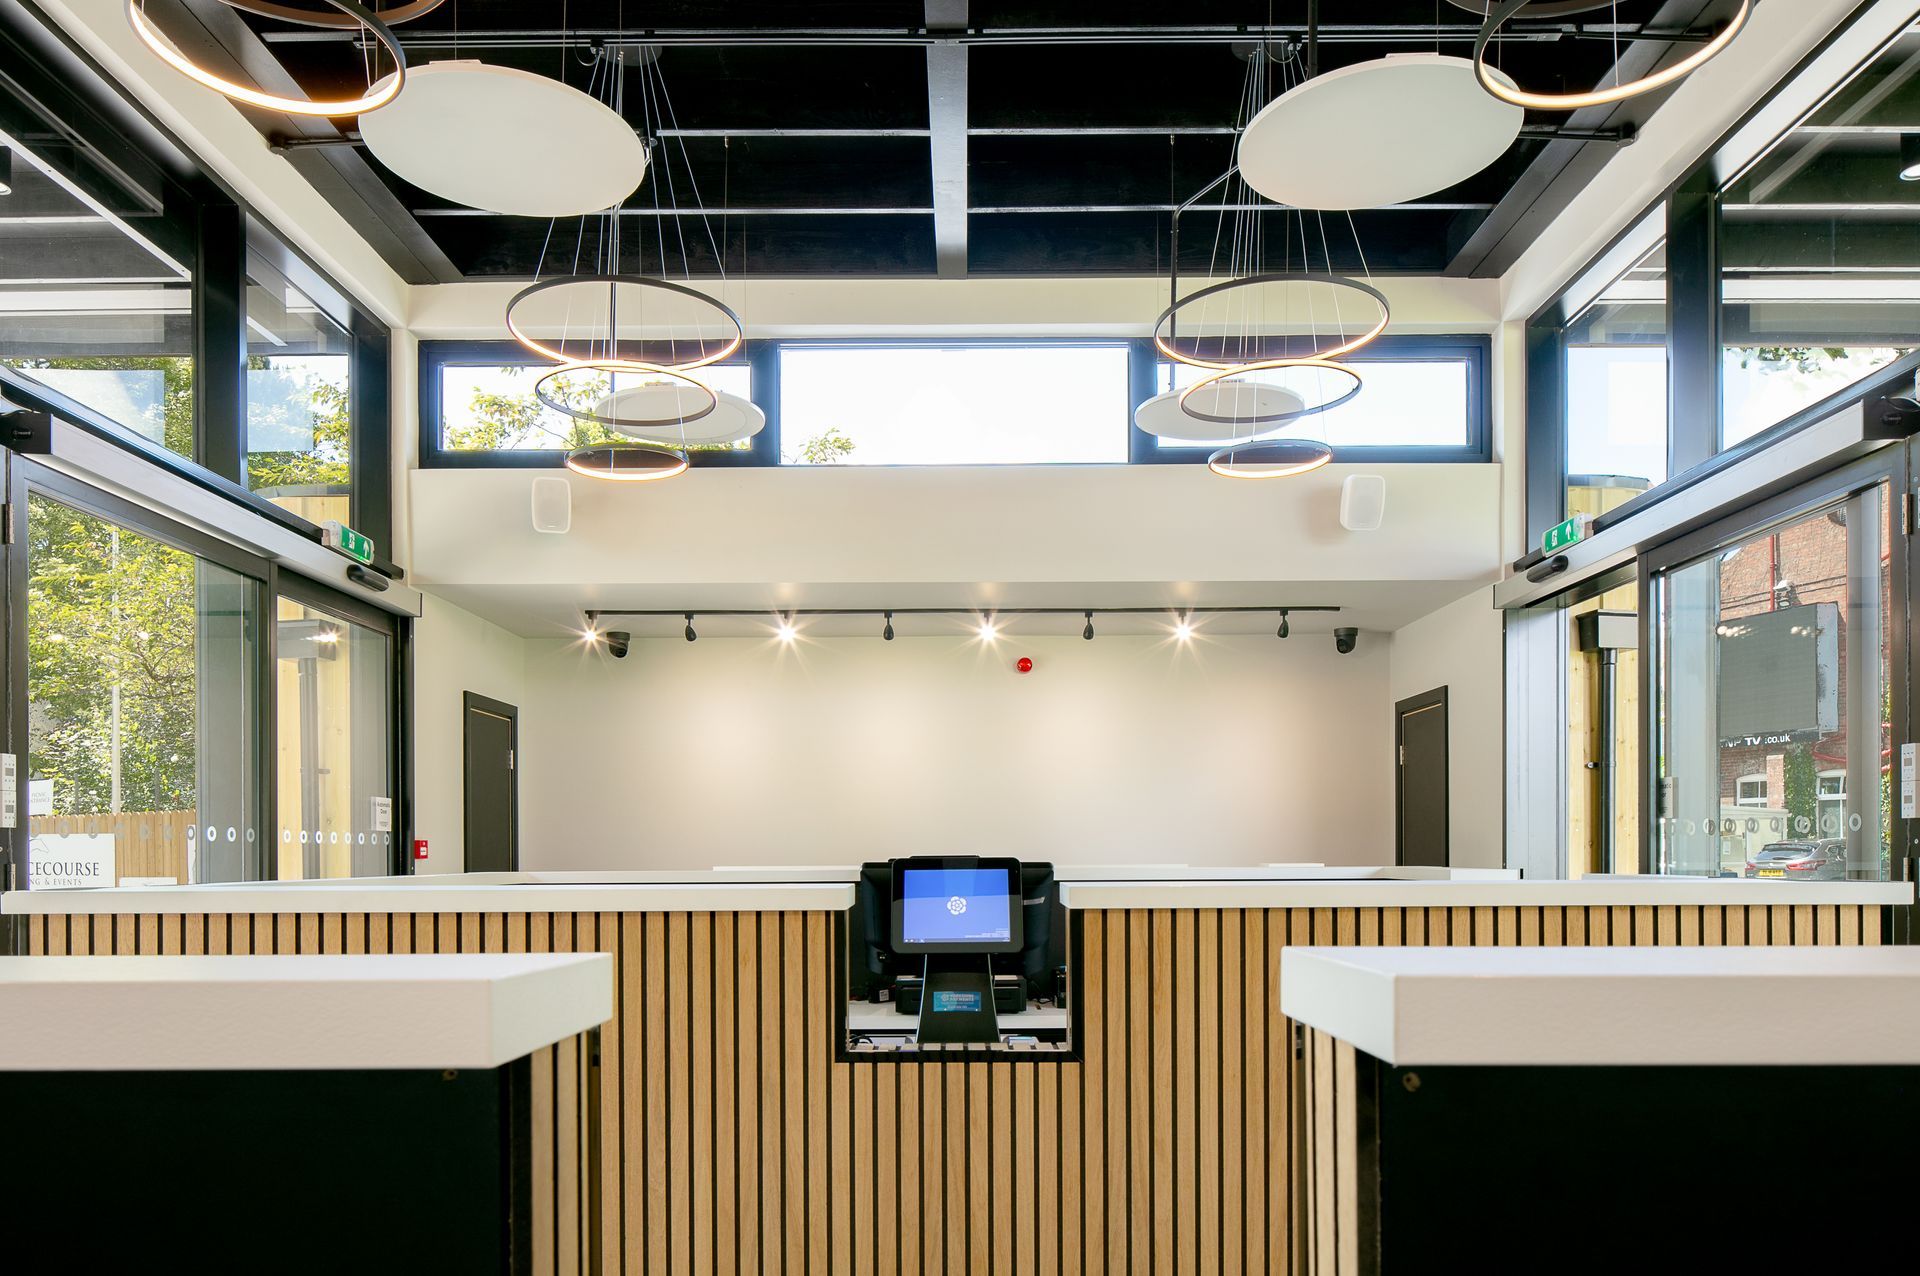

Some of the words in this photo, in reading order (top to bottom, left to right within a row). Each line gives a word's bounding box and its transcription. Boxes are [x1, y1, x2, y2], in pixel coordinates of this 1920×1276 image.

[1744, 736, 1761, 746] TV
[45, 878, 50, 886] &
[53, 878, 82, 886] EVENTS
